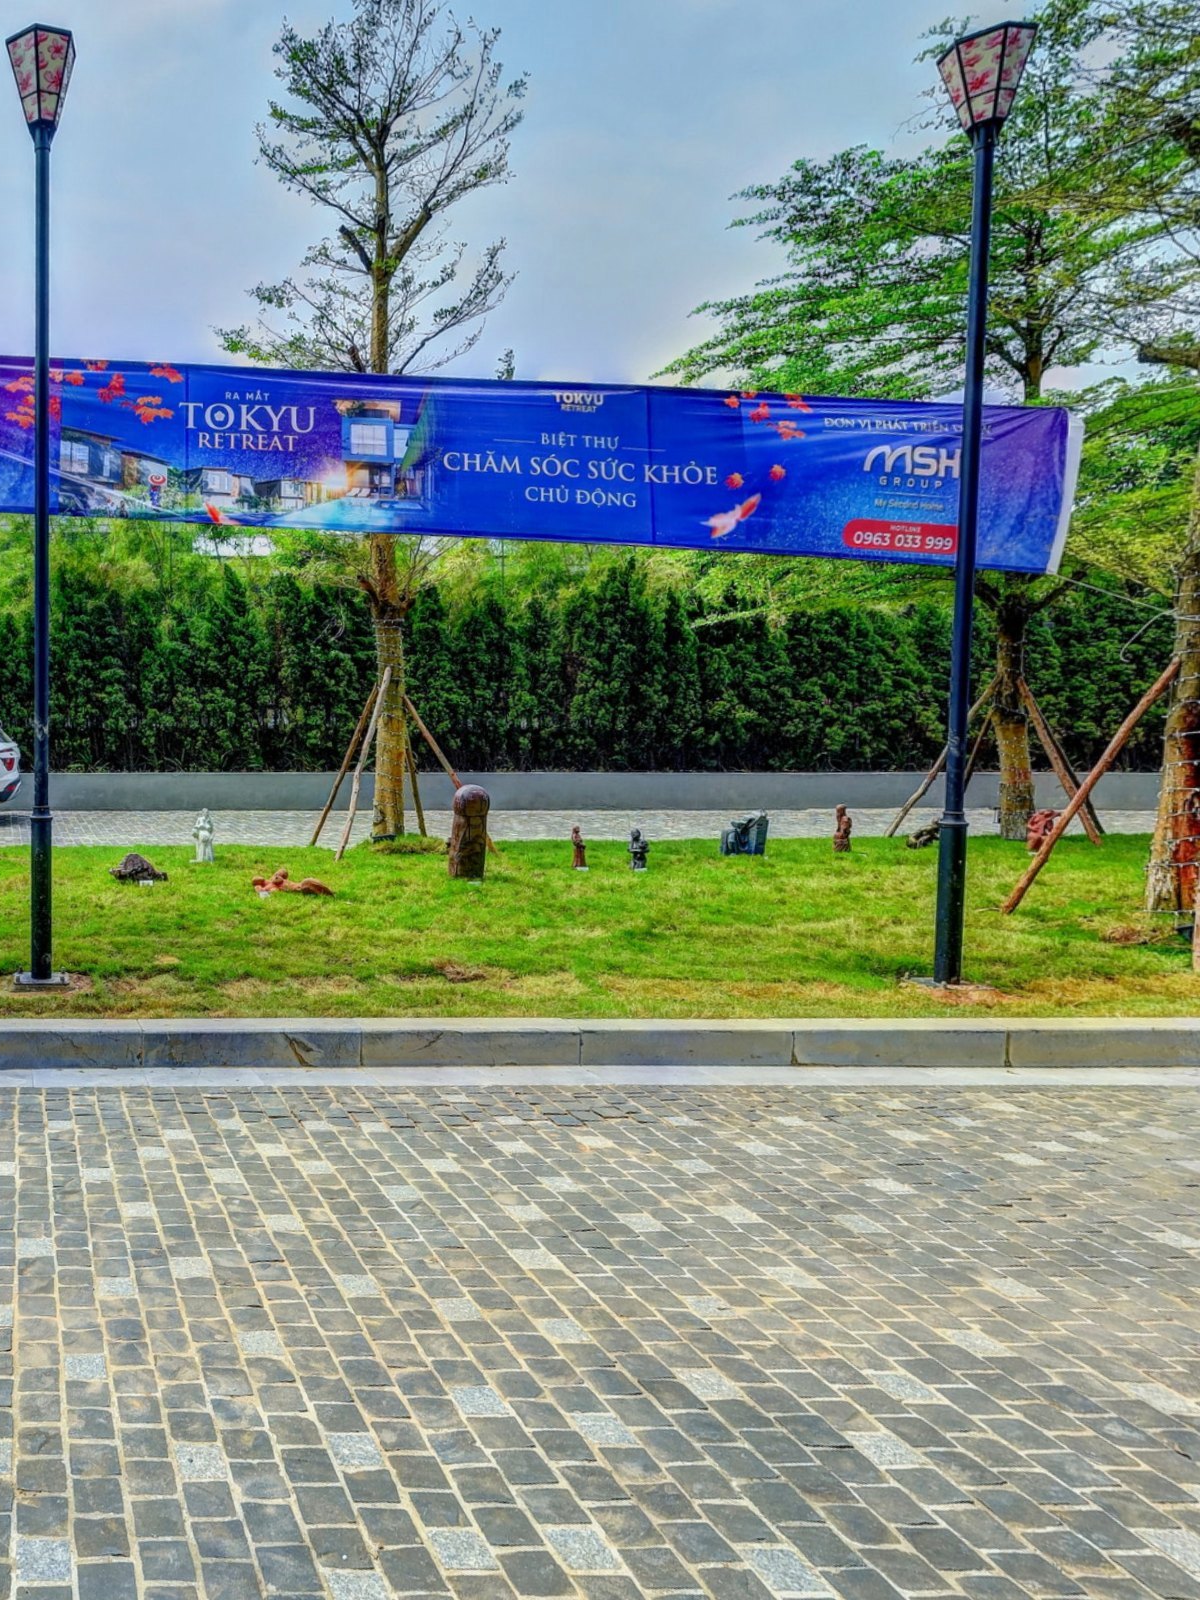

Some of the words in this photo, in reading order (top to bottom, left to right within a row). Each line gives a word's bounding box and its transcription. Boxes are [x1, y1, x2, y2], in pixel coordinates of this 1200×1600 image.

[225, 391, 240, 400] RA
[552, 392, 604, 406] TOKYU
[179, 402, 316, 433] TOKYU
[561, 404, 597, 413] RETREAT
[824, 417, 855, 428] ĐƠN
[876, 418, 908, 431] PHÁT
[198, 432, 299, 451] RETREAT
[541, 431, 578, 448] BIỆT
[582, 435, 619, 451] THỰ
[443, 450, 523, 474] CHĂM
[530, 454, 580, 478] SÓC
[587, 457, 636, 482] SỨC
[644, 460, 718, 485] KHỎE
[863, 444, 961, 478] MSH
[879, 476, 943, 488] GROUP
[525, 484, 569, 503] CHỦ
[576, 487, 636, 508] ĐỘNG
[890, 525, 922, 533] HOTLINE
[853, 531, 891, 547] 0963
[895, 534, 922, 548] 033
[925, 536, 953, 550] 999
